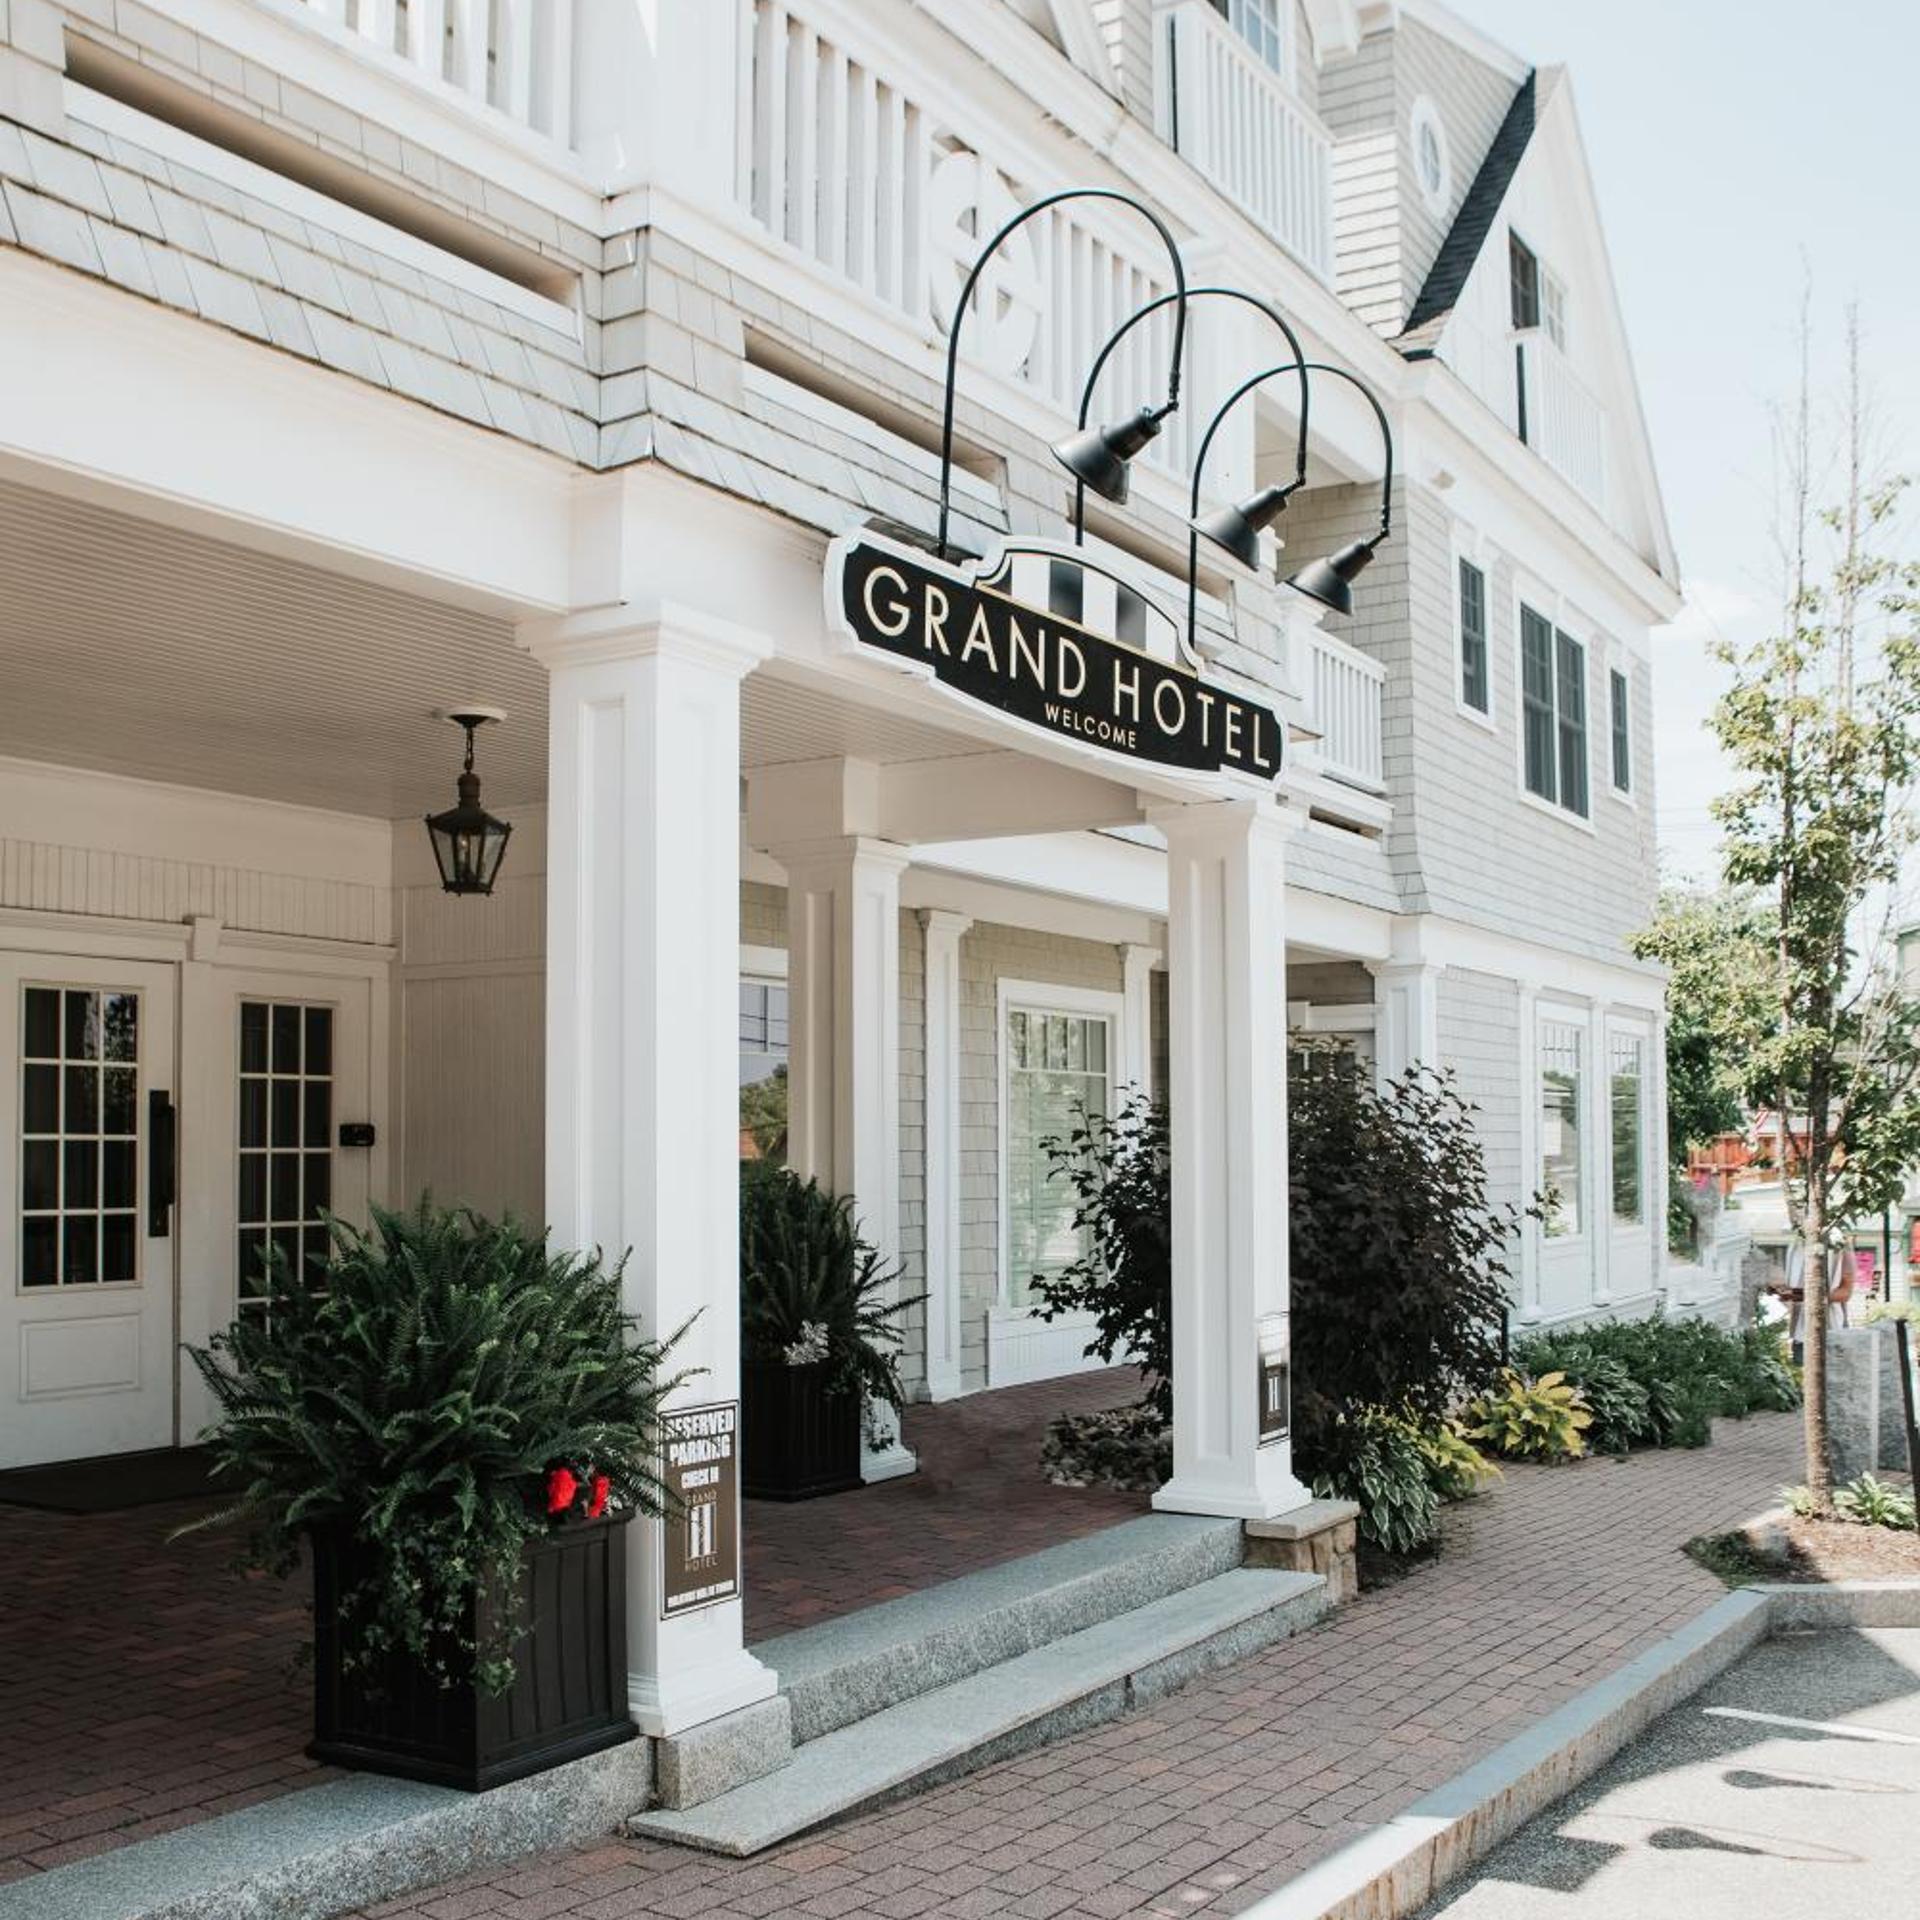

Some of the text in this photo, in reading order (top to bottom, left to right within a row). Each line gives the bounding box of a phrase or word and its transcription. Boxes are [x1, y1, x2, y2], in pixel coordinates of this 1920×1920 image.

[863, 566, 1270, 768] GRAND HOTEL
[1044, 702, 1138, 749] WELCOME
[669, 1433, 731, 1467] PARKING
[684, 1555, 718, 1572] HOTEL
